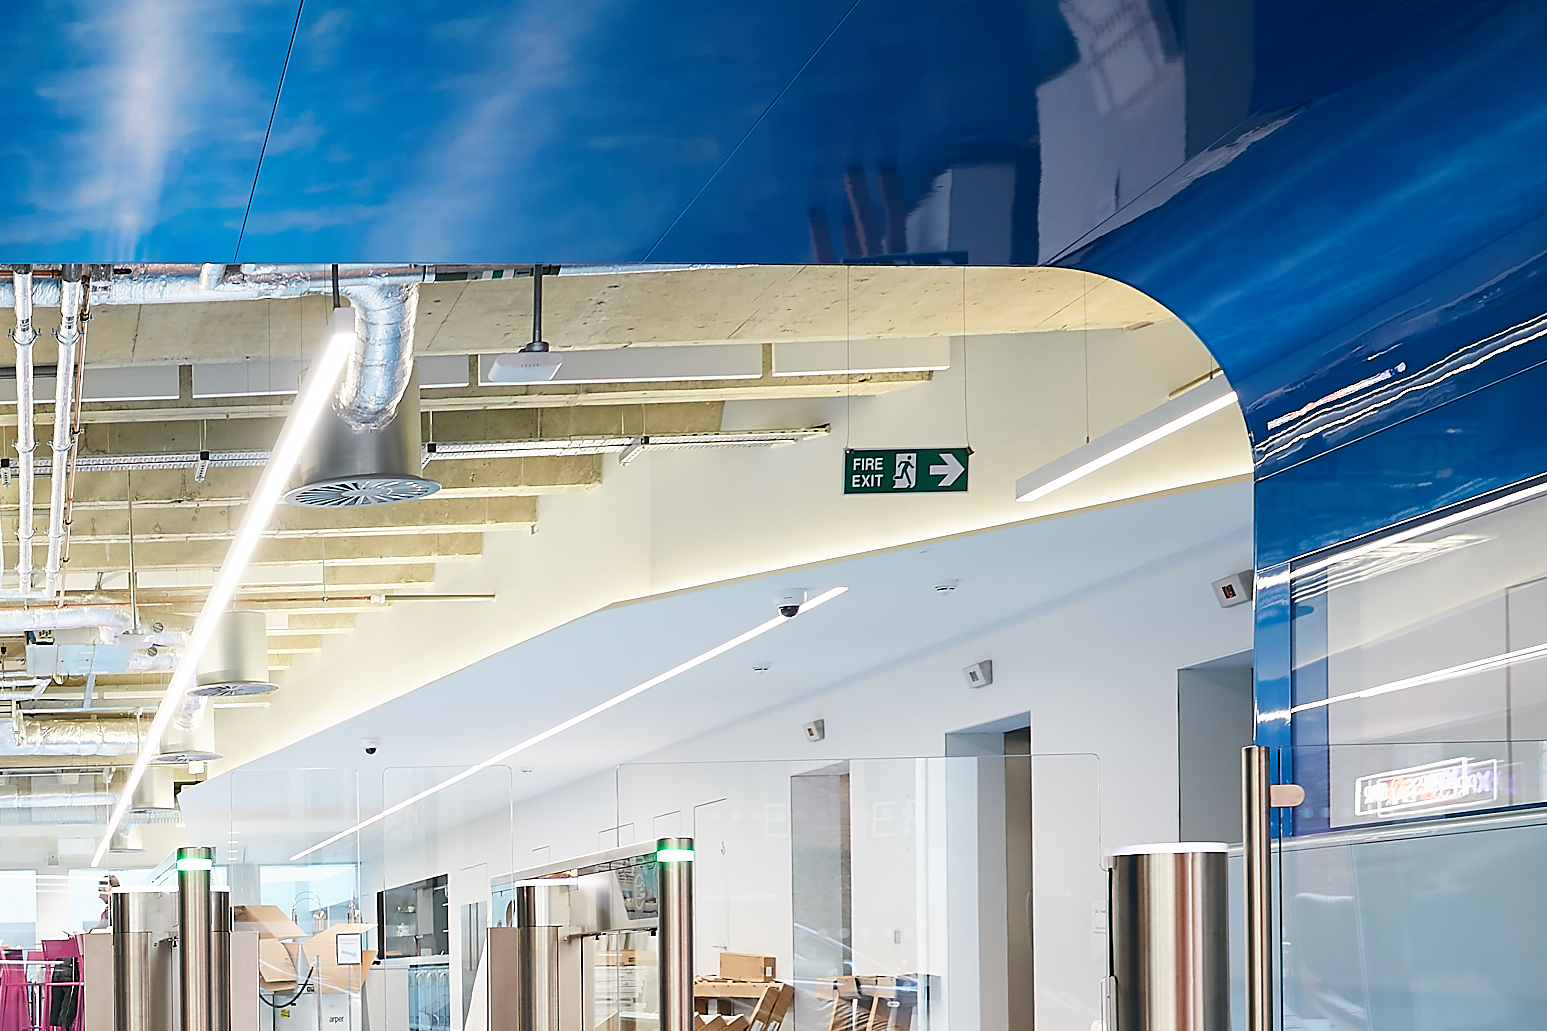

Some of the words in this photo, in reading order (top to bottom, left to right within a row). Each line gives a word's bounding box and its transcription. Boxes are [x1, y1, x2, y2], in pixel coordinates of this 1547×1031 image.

[853, 457, 884, 470] FIRE
[851, 474, 884, 487] EXIT
[329, 1016, 344, 1024] arper
